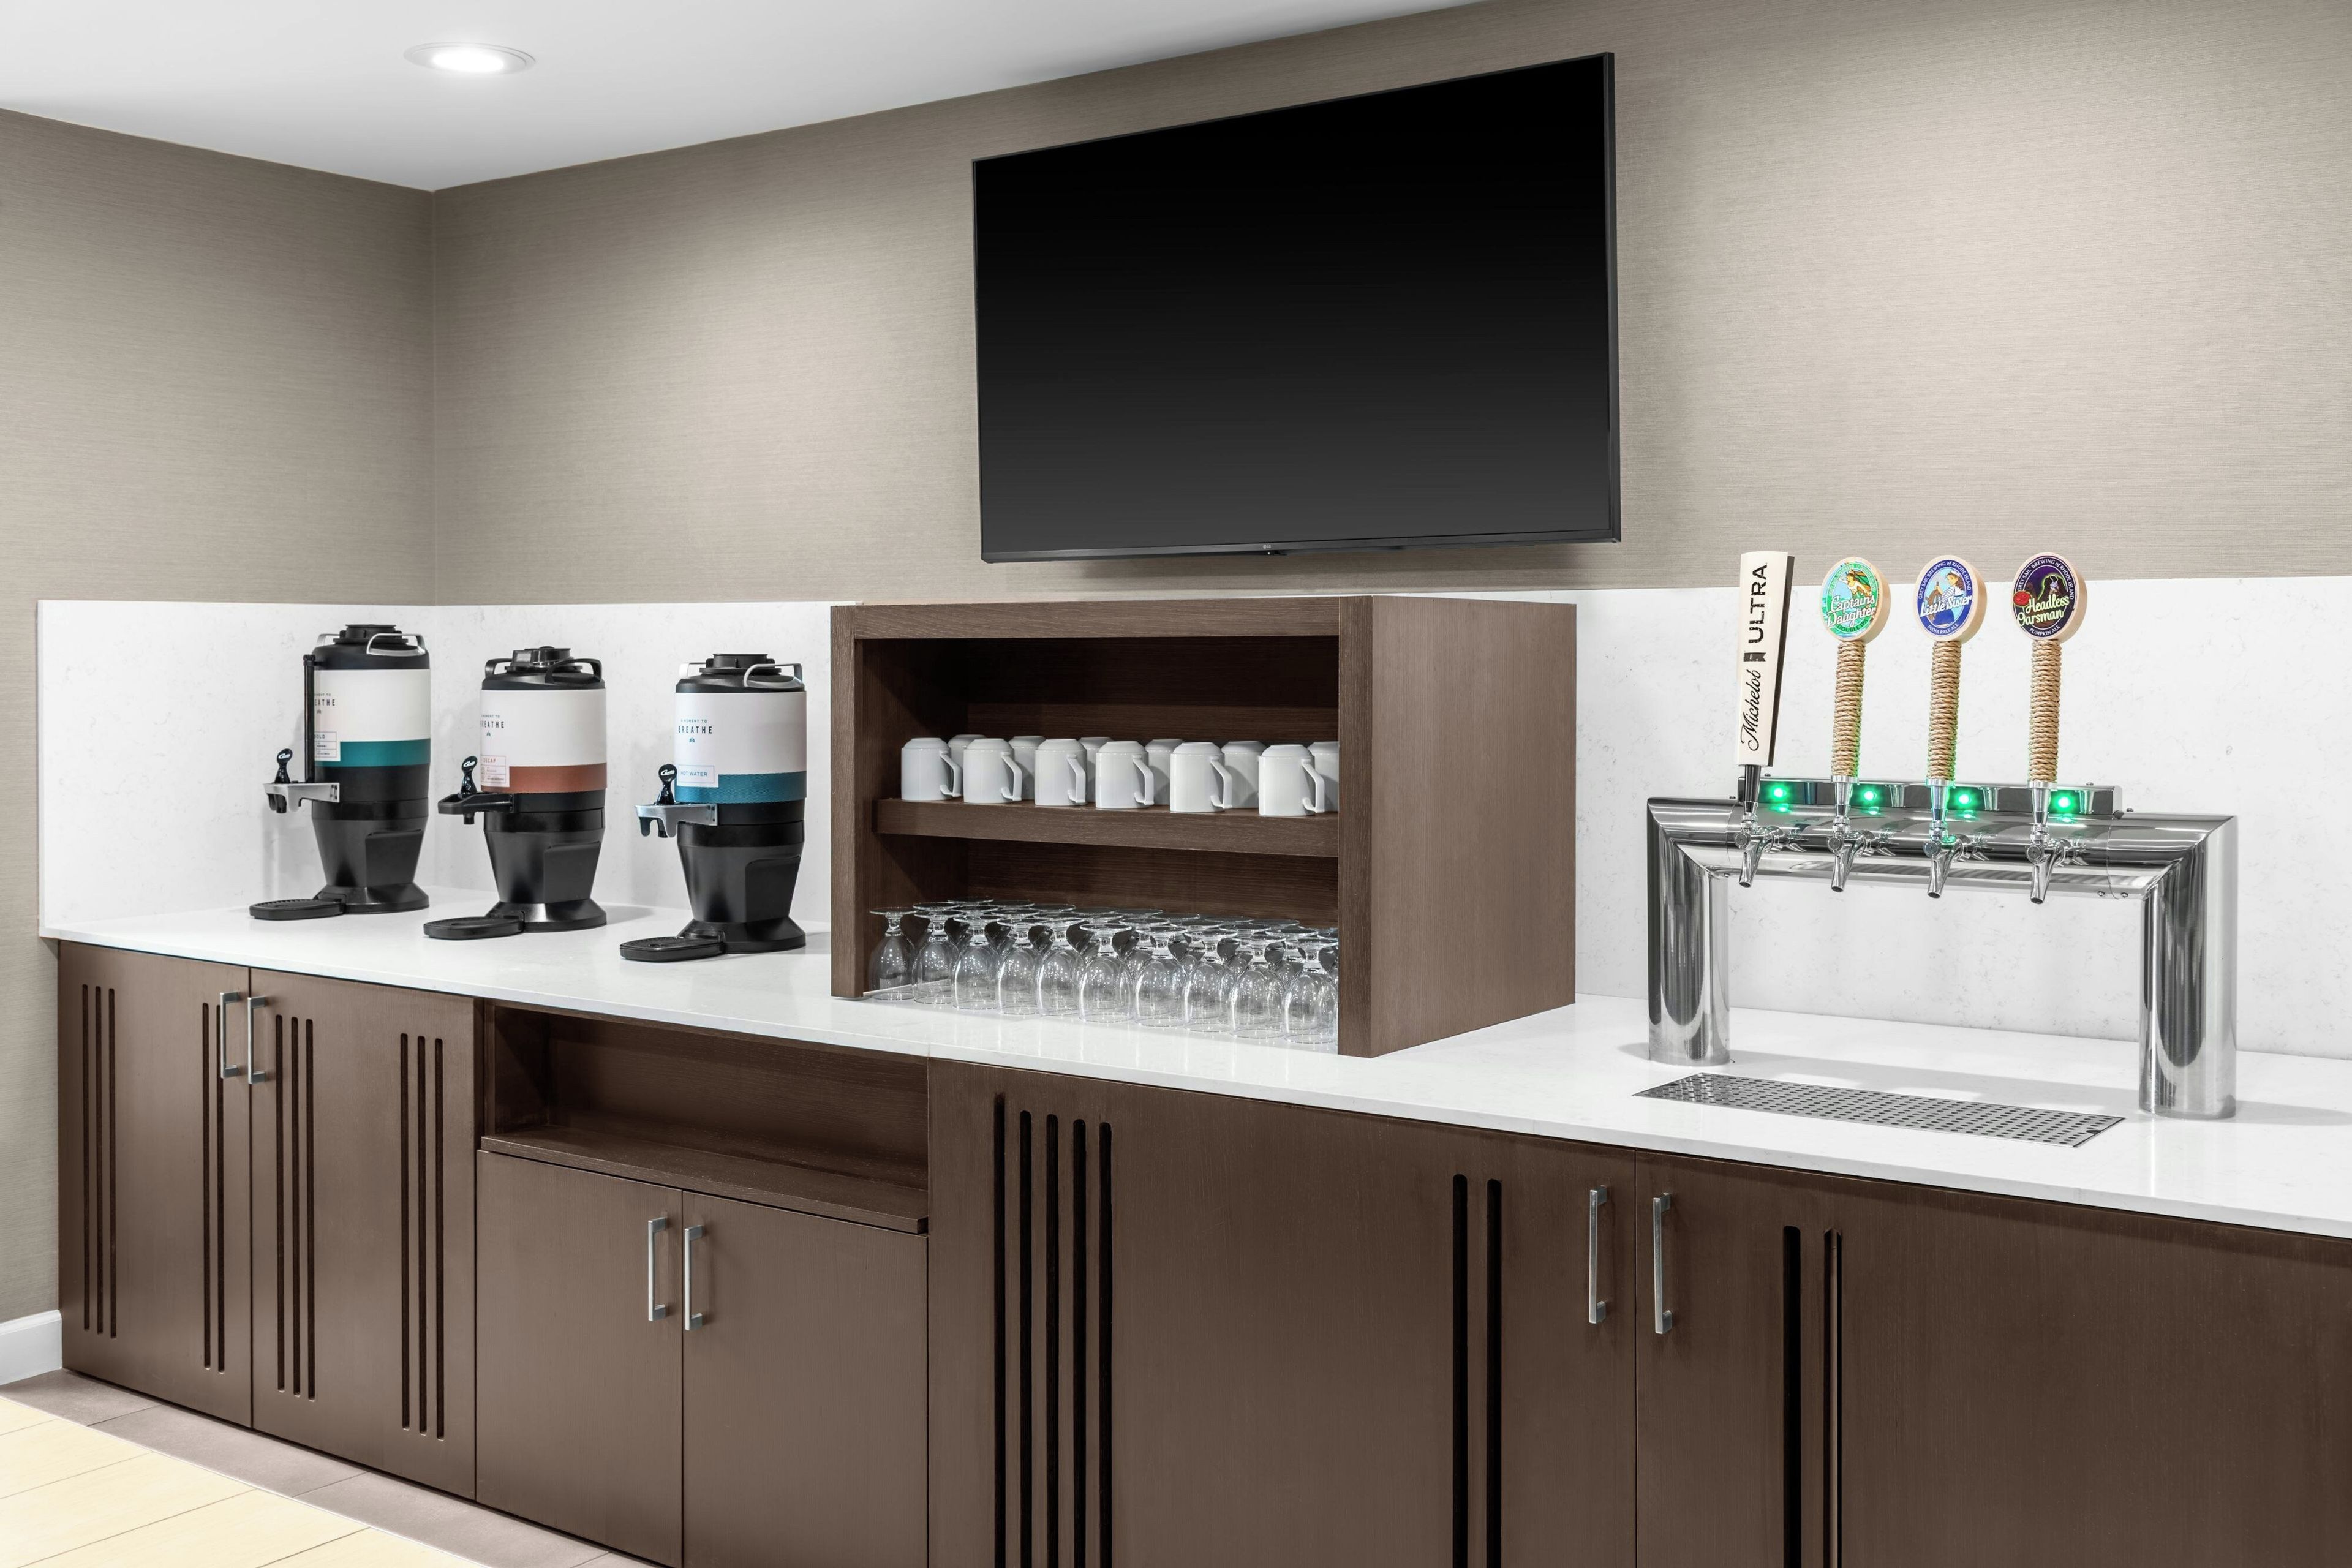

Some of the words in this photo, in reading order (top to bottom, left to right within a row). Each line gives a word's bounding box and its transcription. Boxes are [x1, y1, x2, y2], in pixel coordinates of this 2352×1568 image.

[1928, 561, 1946, 576] BREWING
[1951, 561, 1966, 575] RHODE
[2032, 559, 2055, 568] BREWING
[2060, 565, 2071, 581] RHODE
[1748, 564, 1768, 644] ULTRA
[1920, 600, 1945, 617] Little
[1946, 595, 1972, 610] Sister
[2026, 594, 2070, 614] Headless
[1827, 606, 1877, 627] Daughter
[2017, 609, 2064, 627] Oarsman
[1837, 623, 1860, 632] DOUBLE
[1928, 624, 1939, 635] INDIA
[2029, 627, 2051, 636] PUMPKIN
[1740, 668, 1761, 752] Michelob
[678, 725, 712, 734] BREATHE
